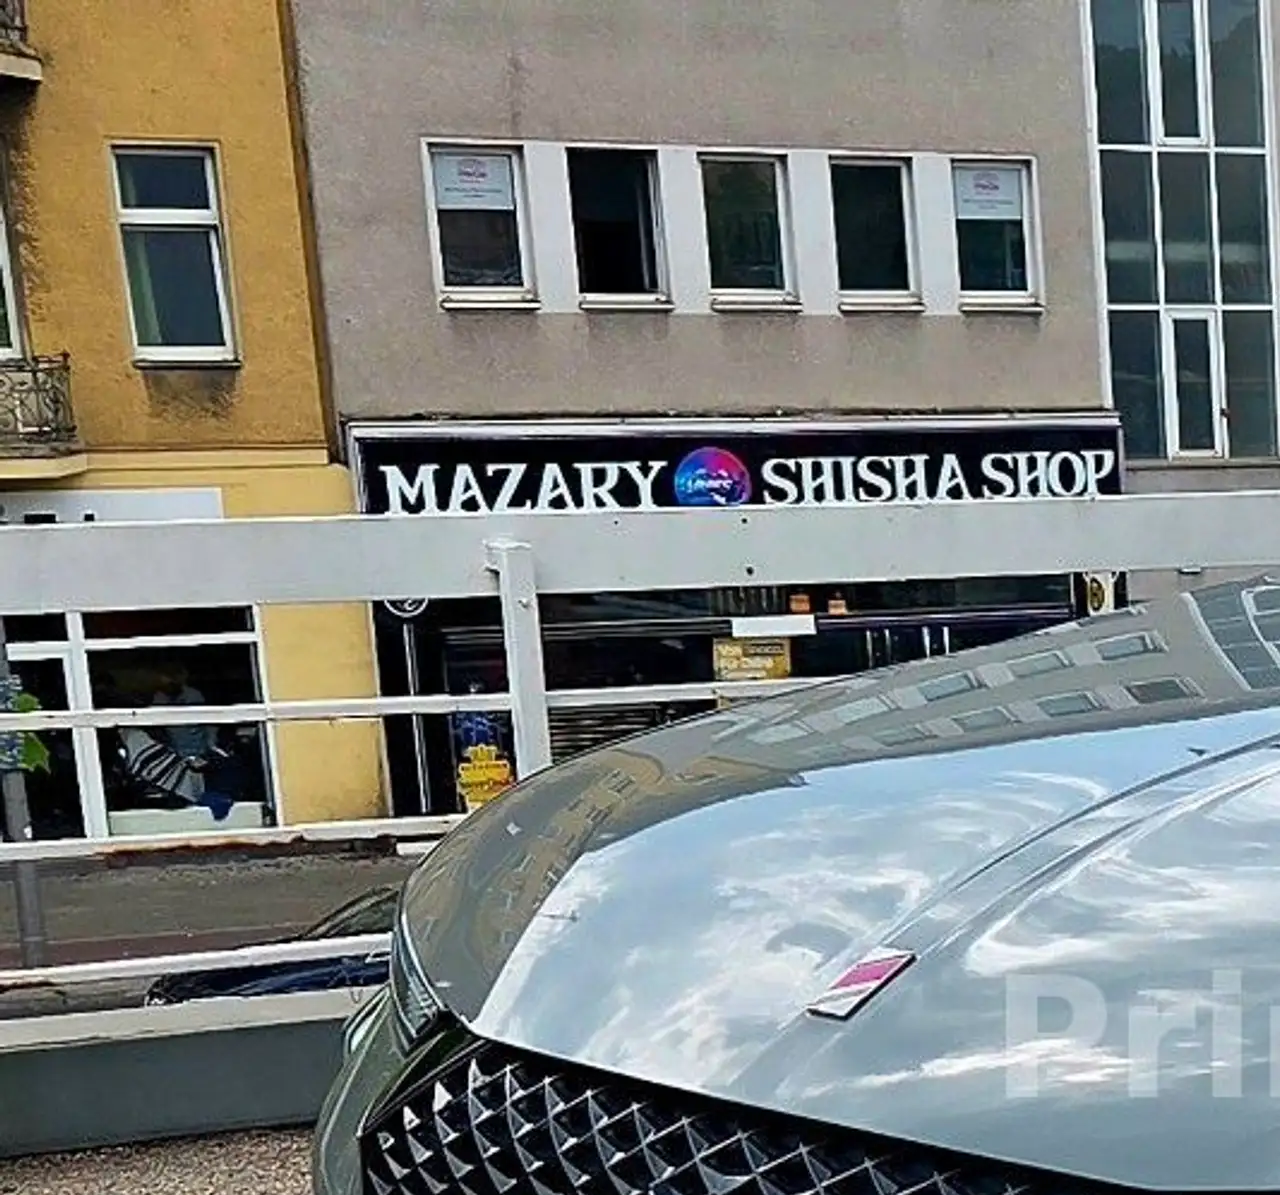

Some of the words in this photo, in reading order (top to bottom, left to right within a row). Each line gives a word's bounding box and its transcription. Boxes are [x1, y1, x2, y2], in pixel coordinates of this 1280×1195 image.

[379, 461, 668, 515] MAZARY
[761, 453, 974, 505] SHISHA
[981, 449, 1116, 499] SHOP
